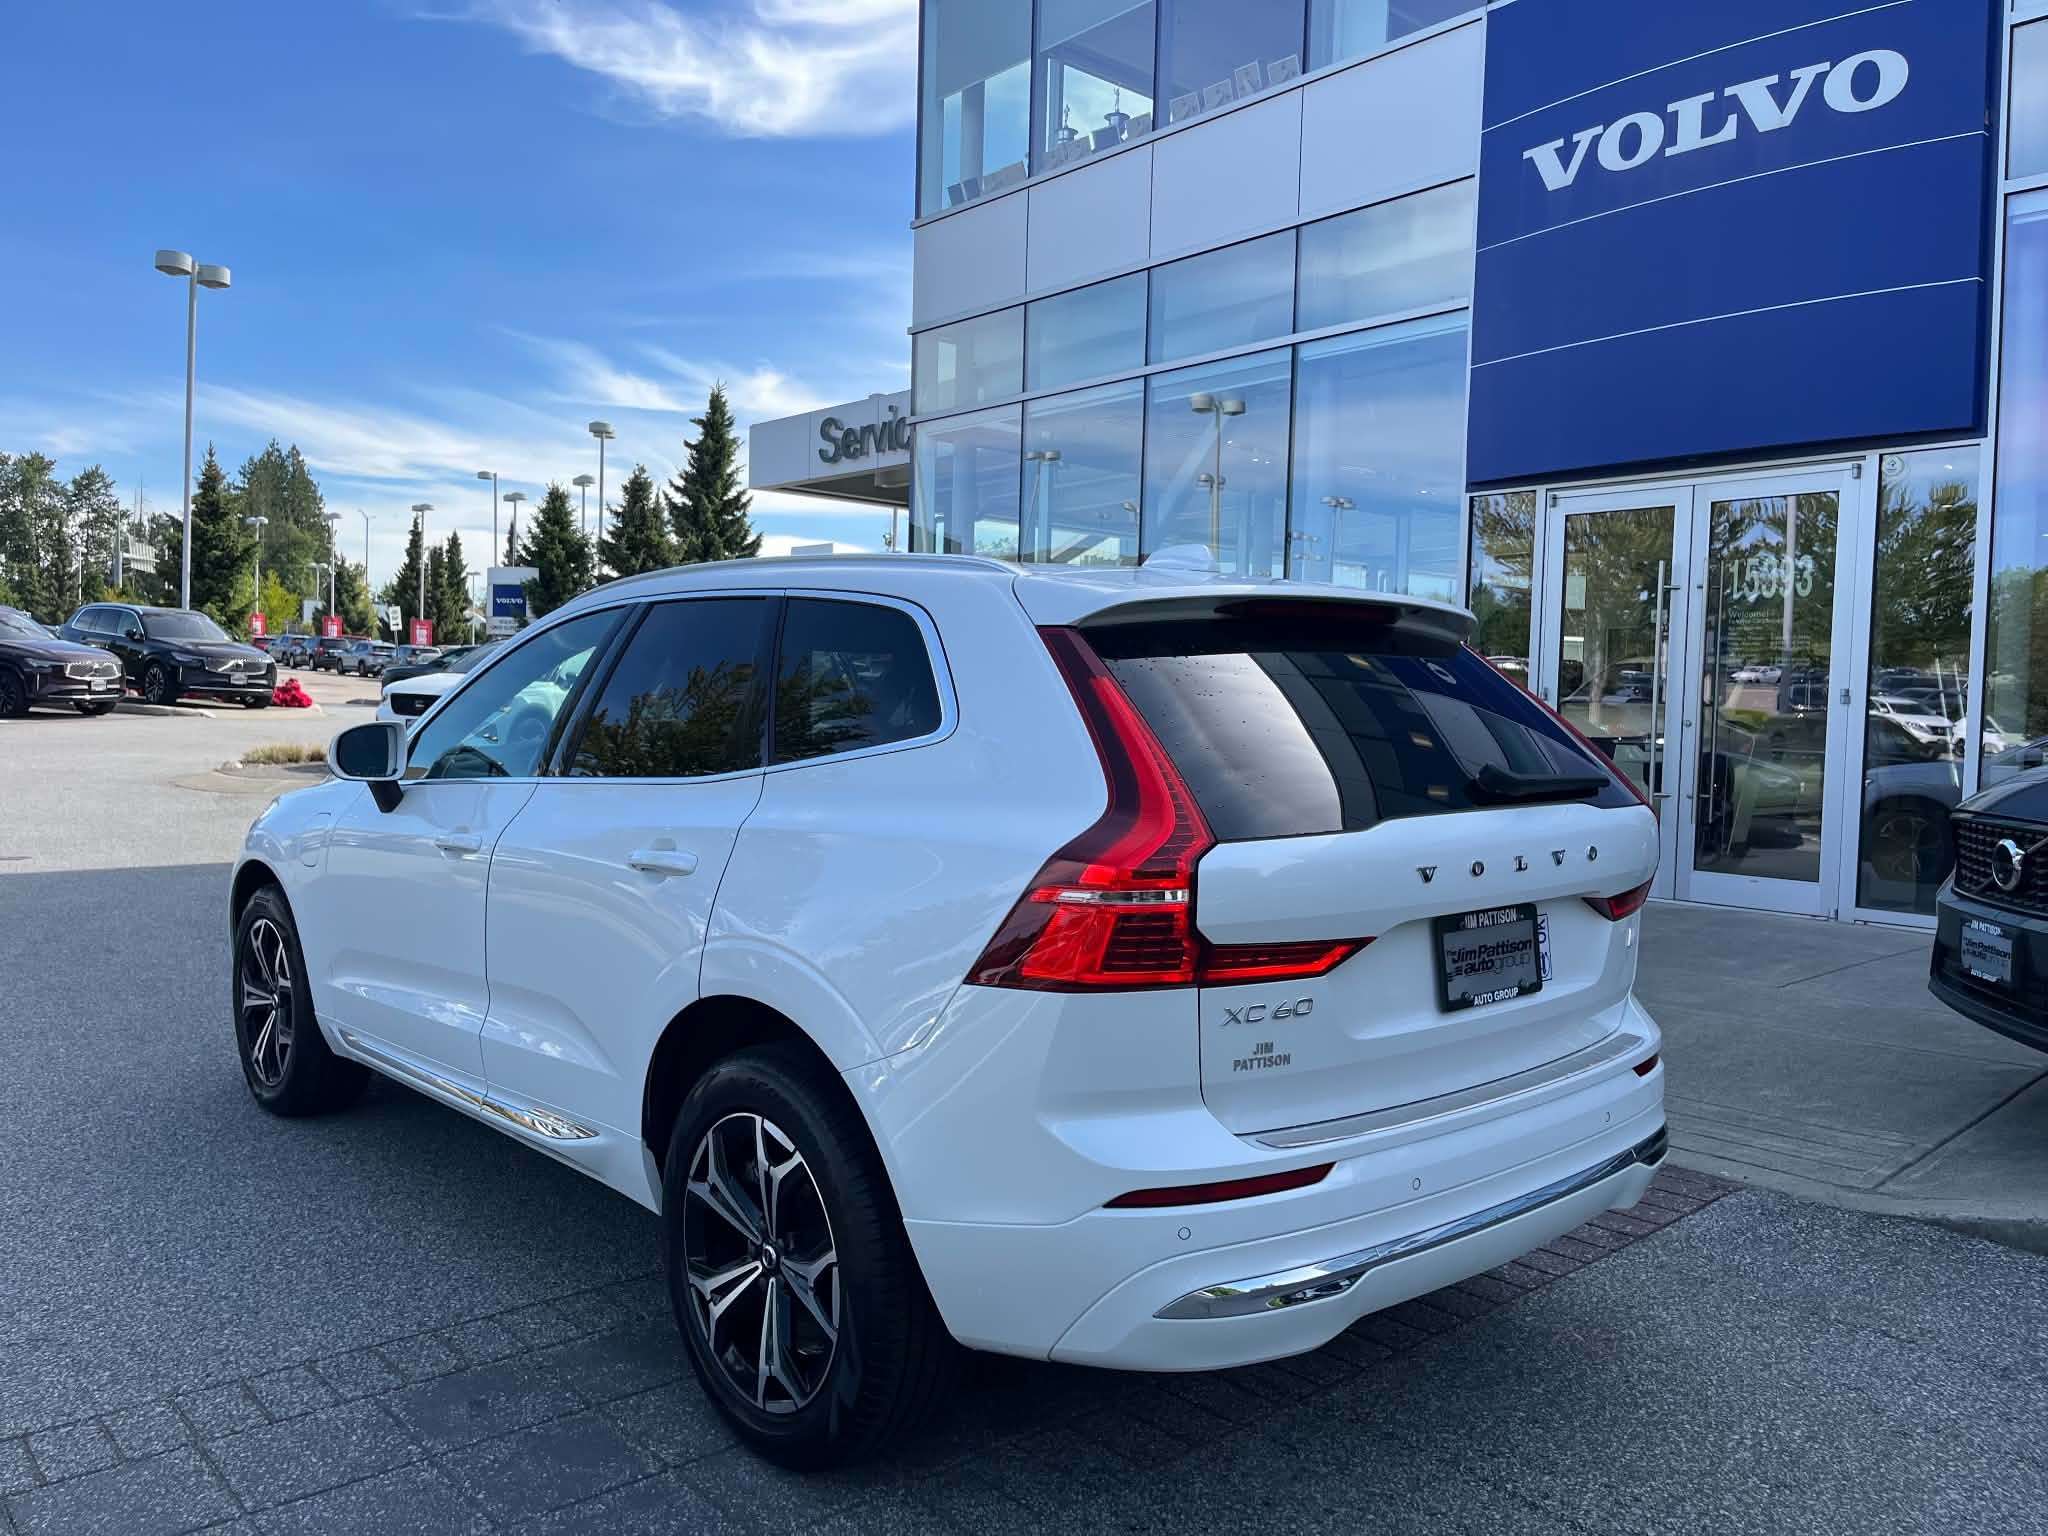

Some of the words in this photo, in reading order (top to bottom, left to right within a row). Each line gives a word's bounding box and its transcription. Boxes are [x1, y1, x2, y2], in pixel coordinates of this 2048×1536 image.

[1522, 49, 1909, 192] VOLVO
[495, 597, 524, 605] VOLVO
[1416, 845, 1598, 883] VOLVO
[1480, 907, 1518, 928] PATTISON
[1452, 947, 1476, 963] Jim
[1478, 938, 1532, 961] Pattison
[1474, 994, 1493, 1006] AUTO
[1494, 986, 1519, 1002] GROUP
[1253, 1041, 1274, 1056] JIM
[1232, 1054, 1292, 1072] PATTISON
